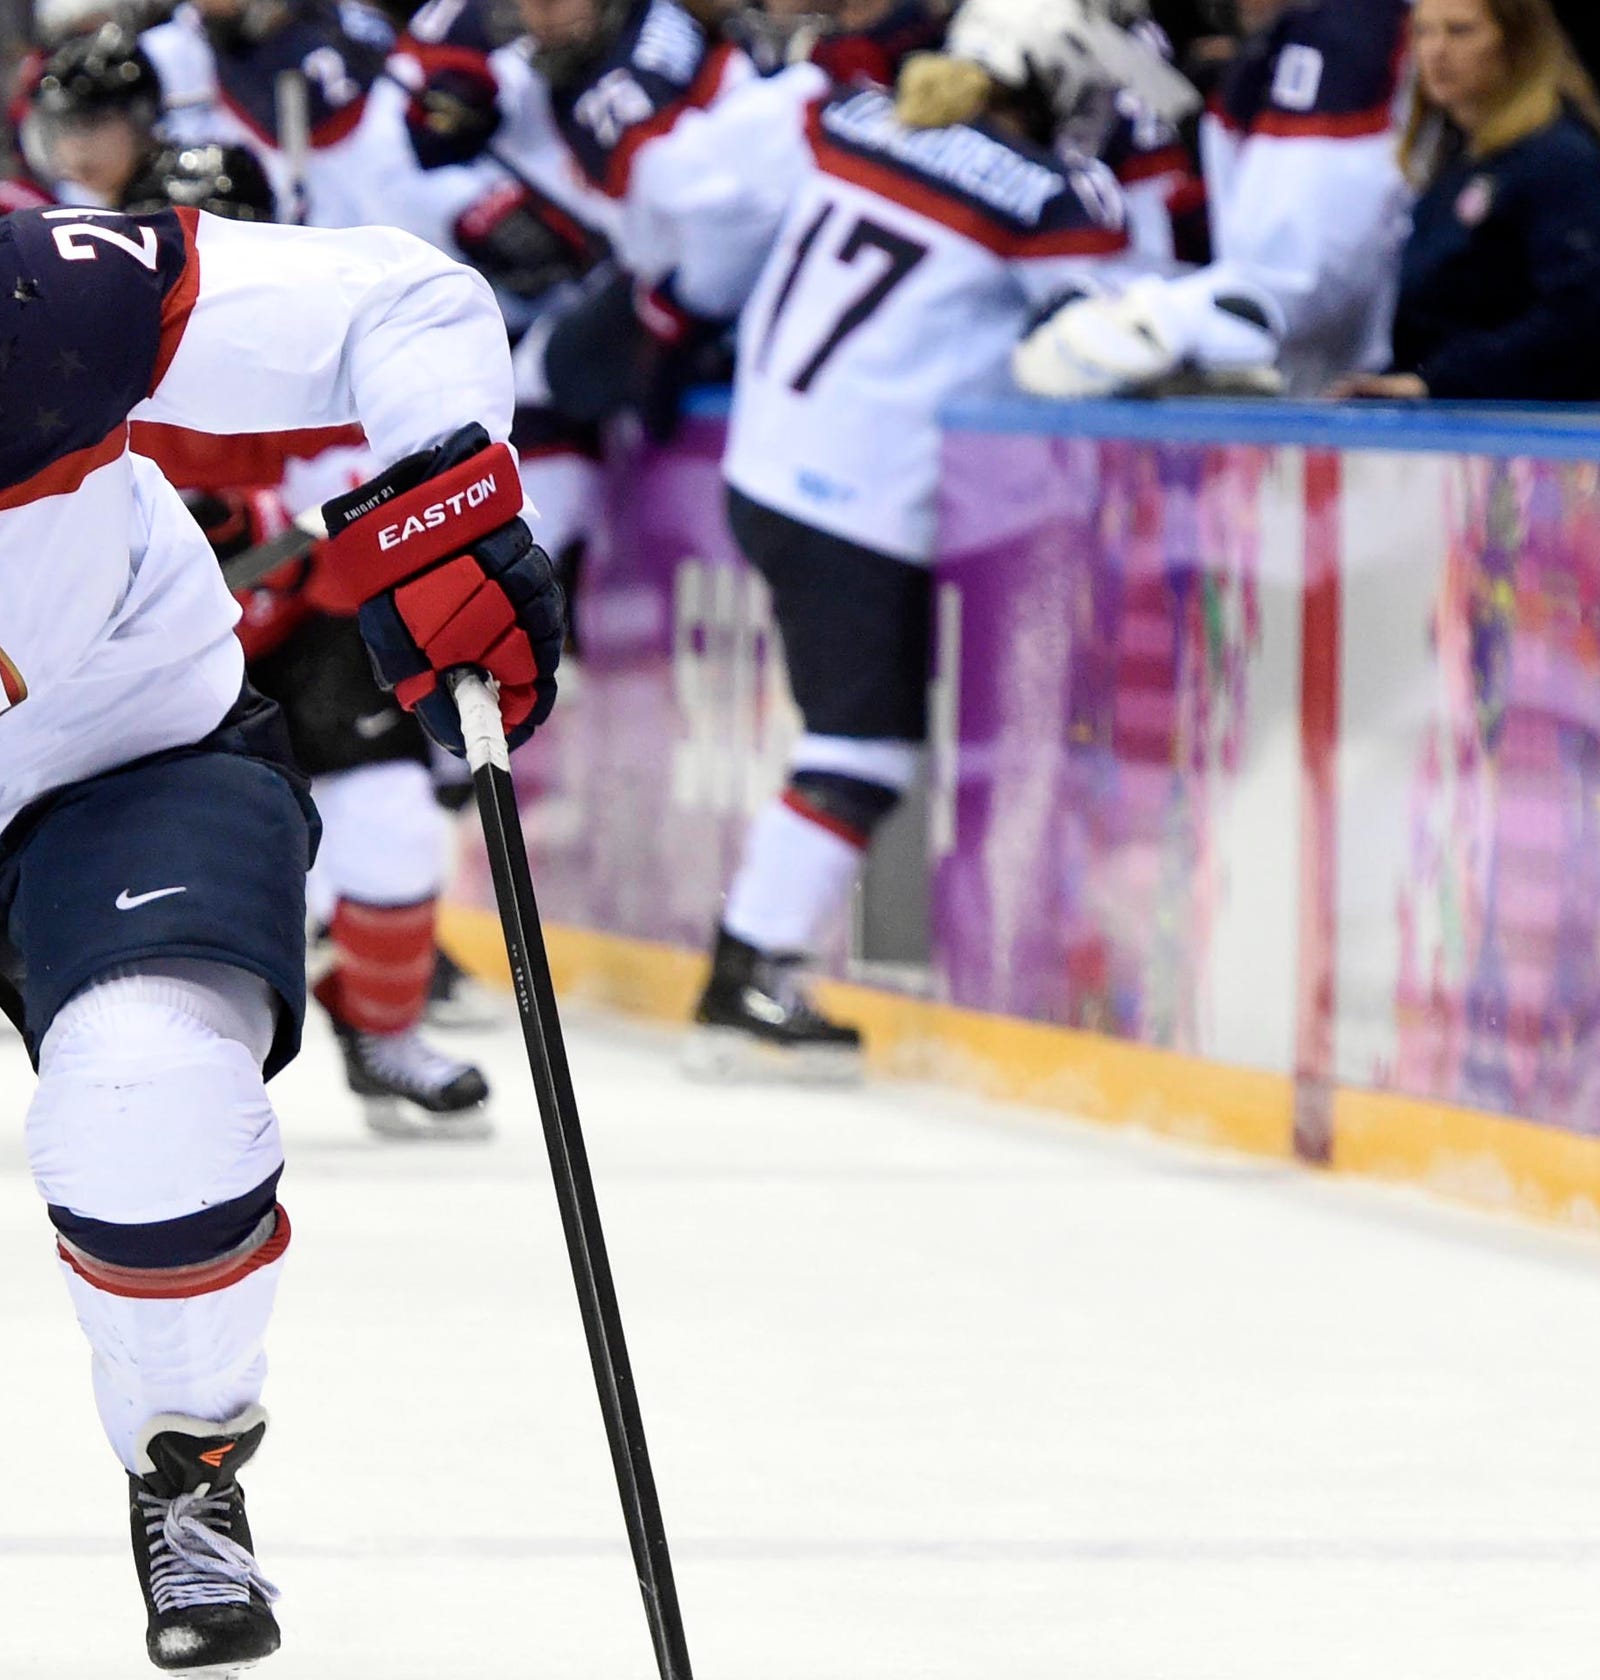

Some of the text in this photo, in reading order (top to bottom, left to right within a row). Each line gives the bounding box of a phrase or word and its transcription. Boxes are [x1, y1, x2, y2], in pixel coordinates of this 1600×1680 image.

[752, 202, 931, 395] 17
[343, 485, 396, 521] KNIGHT 21
[377, 473, 498, 551] EASTON
